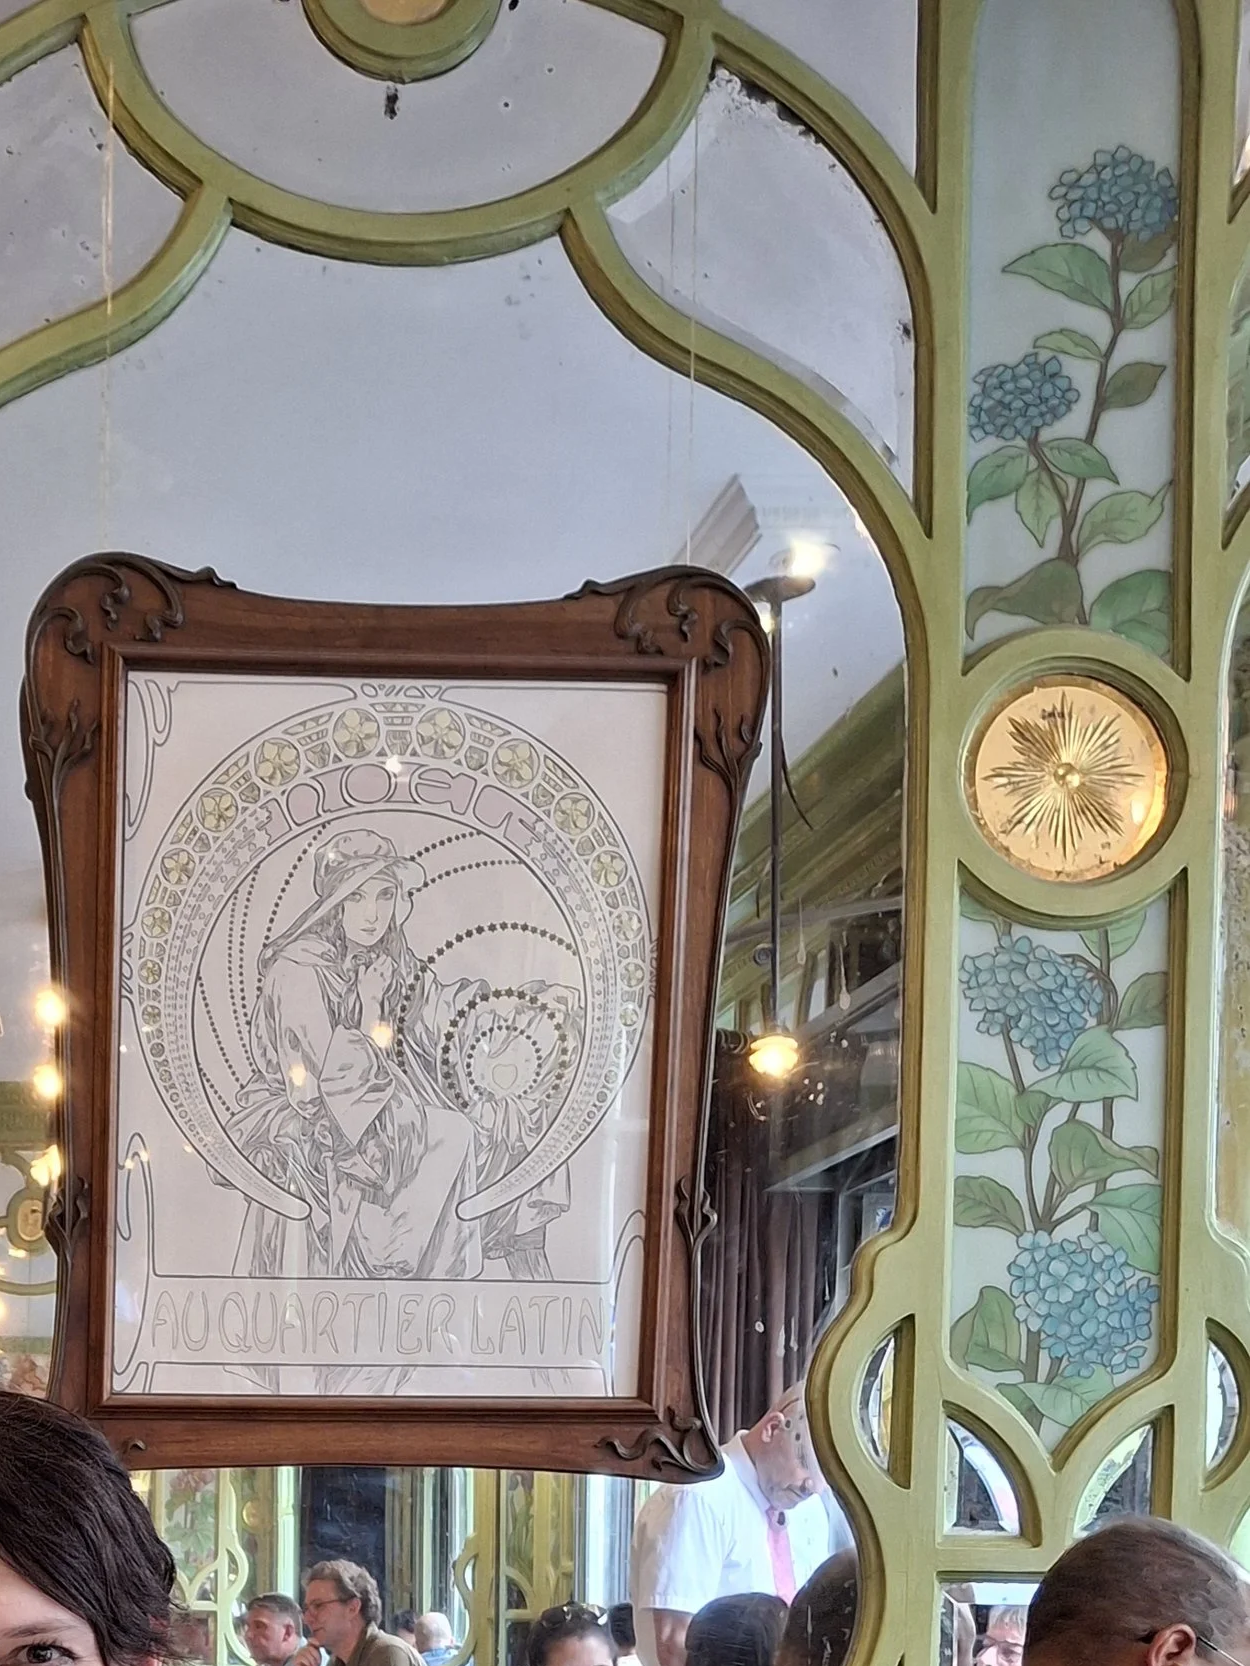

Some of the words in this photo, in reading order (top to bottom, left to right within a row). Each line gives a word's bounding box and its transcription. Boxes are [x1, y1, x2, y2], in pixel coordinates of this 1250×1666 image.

[151, 1290, 210, 1352] AU
[218, 1290, 456, 1355] QUARTIER
[471, 1294, 606, 1356] LATIN
